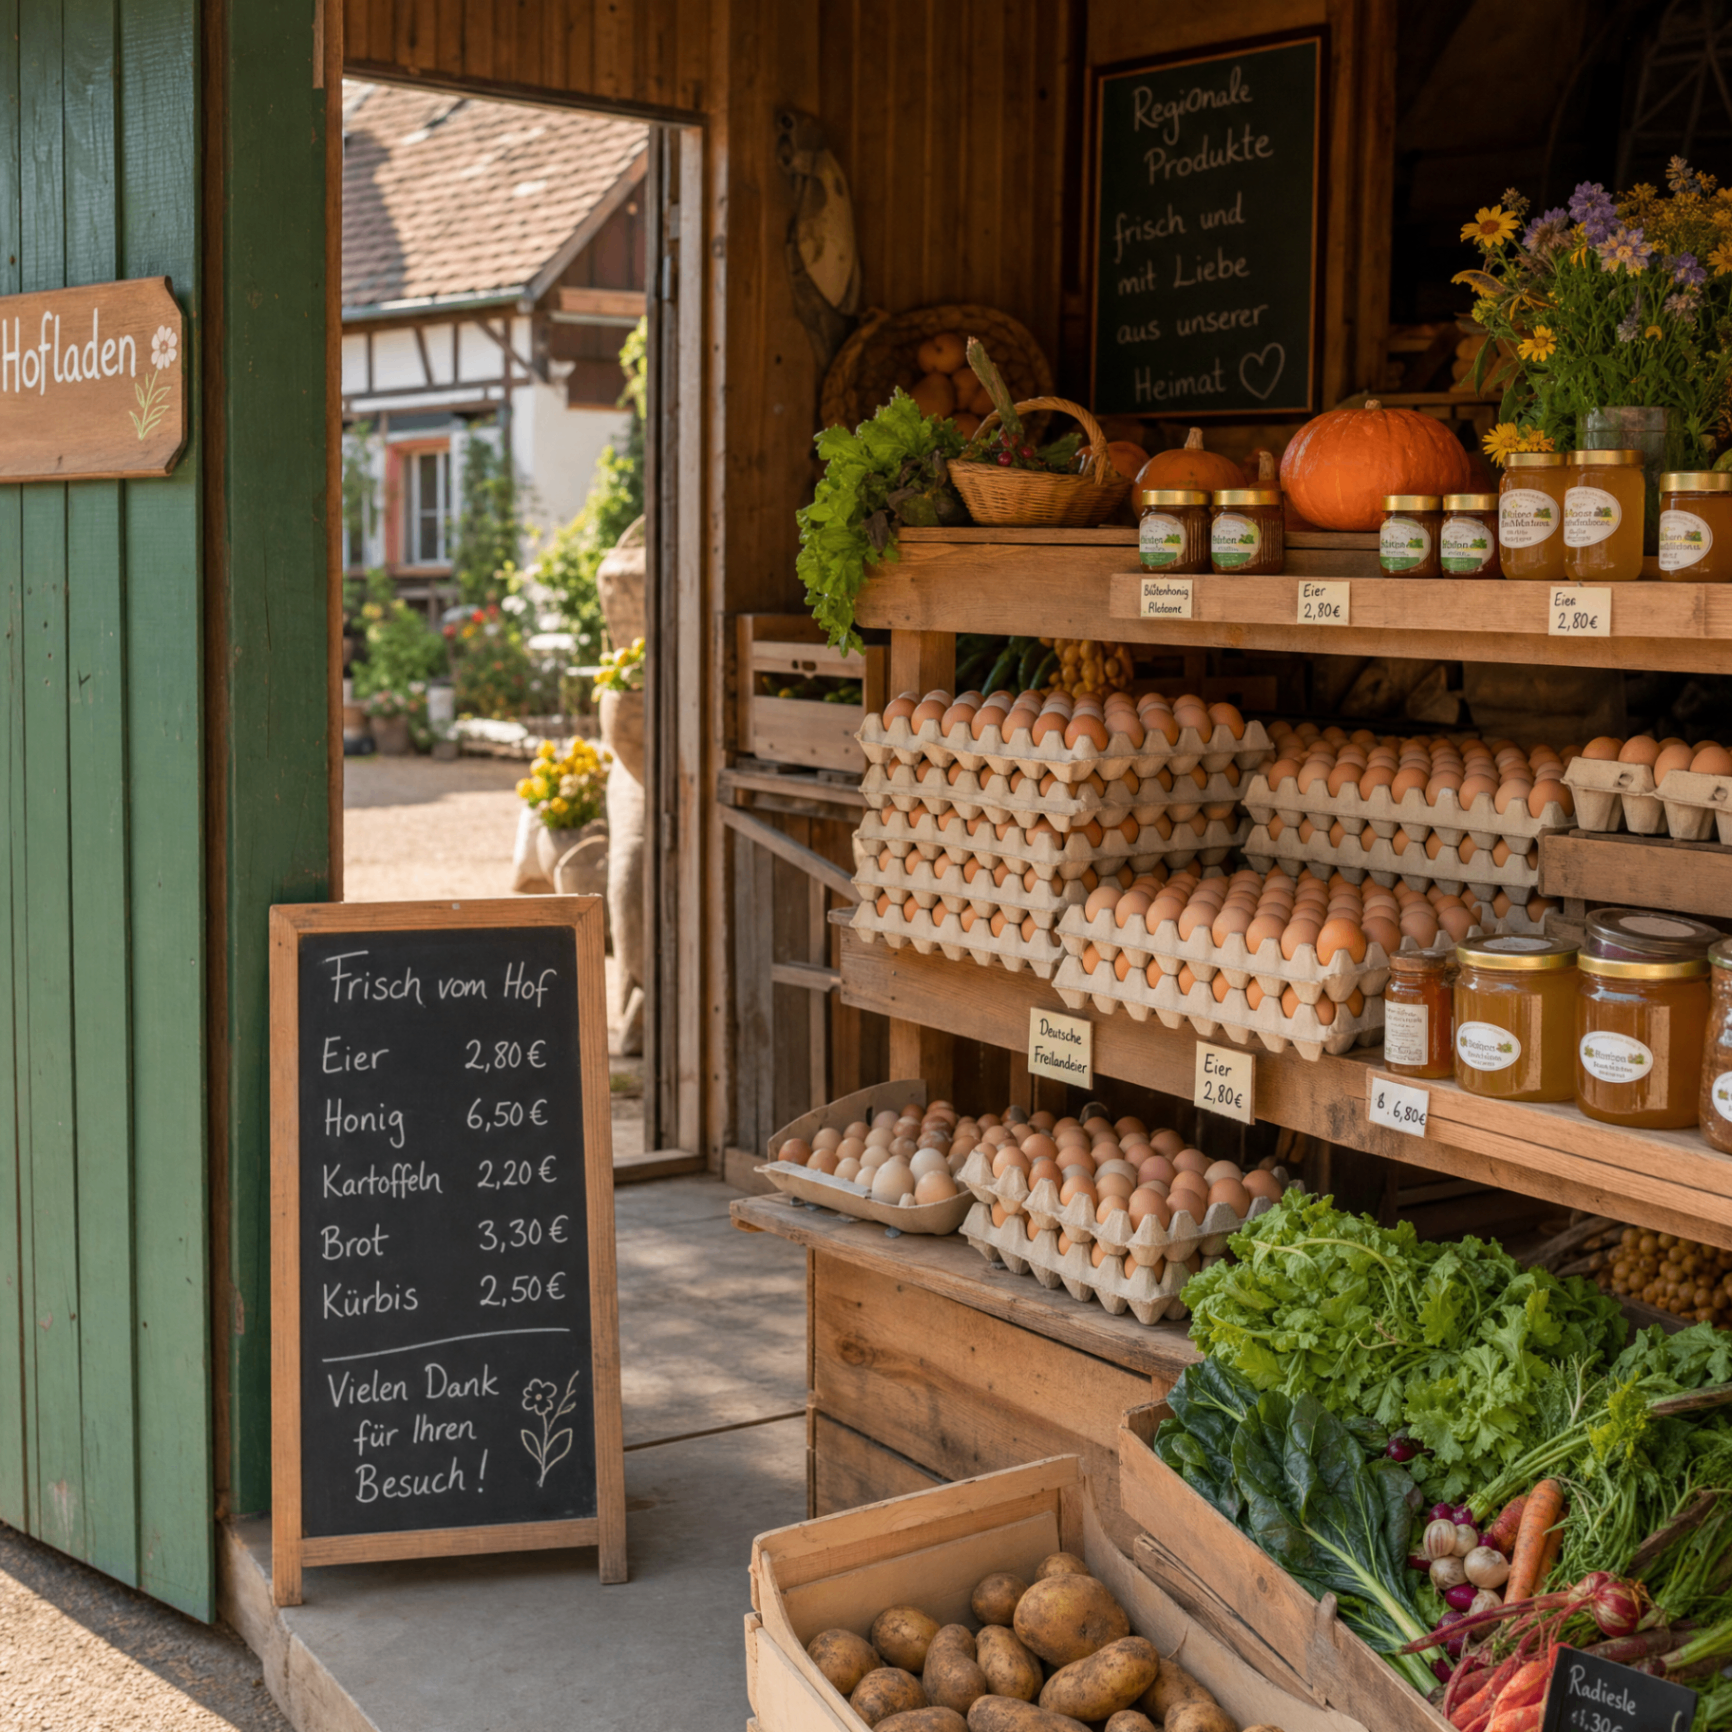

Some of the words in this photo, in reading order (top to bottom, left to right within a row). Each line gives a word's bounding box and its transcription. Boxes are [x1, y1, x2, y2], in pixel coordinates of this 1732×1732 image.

[1143, 122, 1274, 185] Produkte
[1113, 202, 1187, 265] frisch
[1200, 190, 1246, 230] und
[1117, 258, 1157, 296] mit
[1172, 246, 1251, 289] Liebe
[1116, 319, 1162, 345] aus
[1176, 303, 1269, 337] unserer
[2, 307, 137, 396] Hofladen
[1134, 356, 1227, 404] Heimat
[1303, 583, 1327, 598] Eier
[1304, 602, 1341, 621] 2,80€
[1557, 612, 1599, 632] 2,80€
[322, 950, 426, 1008] Frisch
[438, 977, 488, 1000] vom
[503, 961, 558, 1008] Hof
[1039, 1018, 1083, 1046] Deutsche
[322, 1035, 390, 1074] Eier
[1033, 1045, 1088, 1075] Freilandeier
[1203, 1053, 1233, 1077] Eier
[1203, 1080, 1243, 1109] 2,80€
[325, 1097, 405, 1149] Honig
[323, 1160, 444, 1200] Kartoffeln
[320, 1223, 390, 1261] Brot
[323, 1279, 418, 1319] Kürbis
[327, 1368, 409, 1408] Vielen
[424, 1362, 500, 1399] Dank
[353, 1419, 399, 1457] für
[413, 1413, 478, 1444] Ihren
